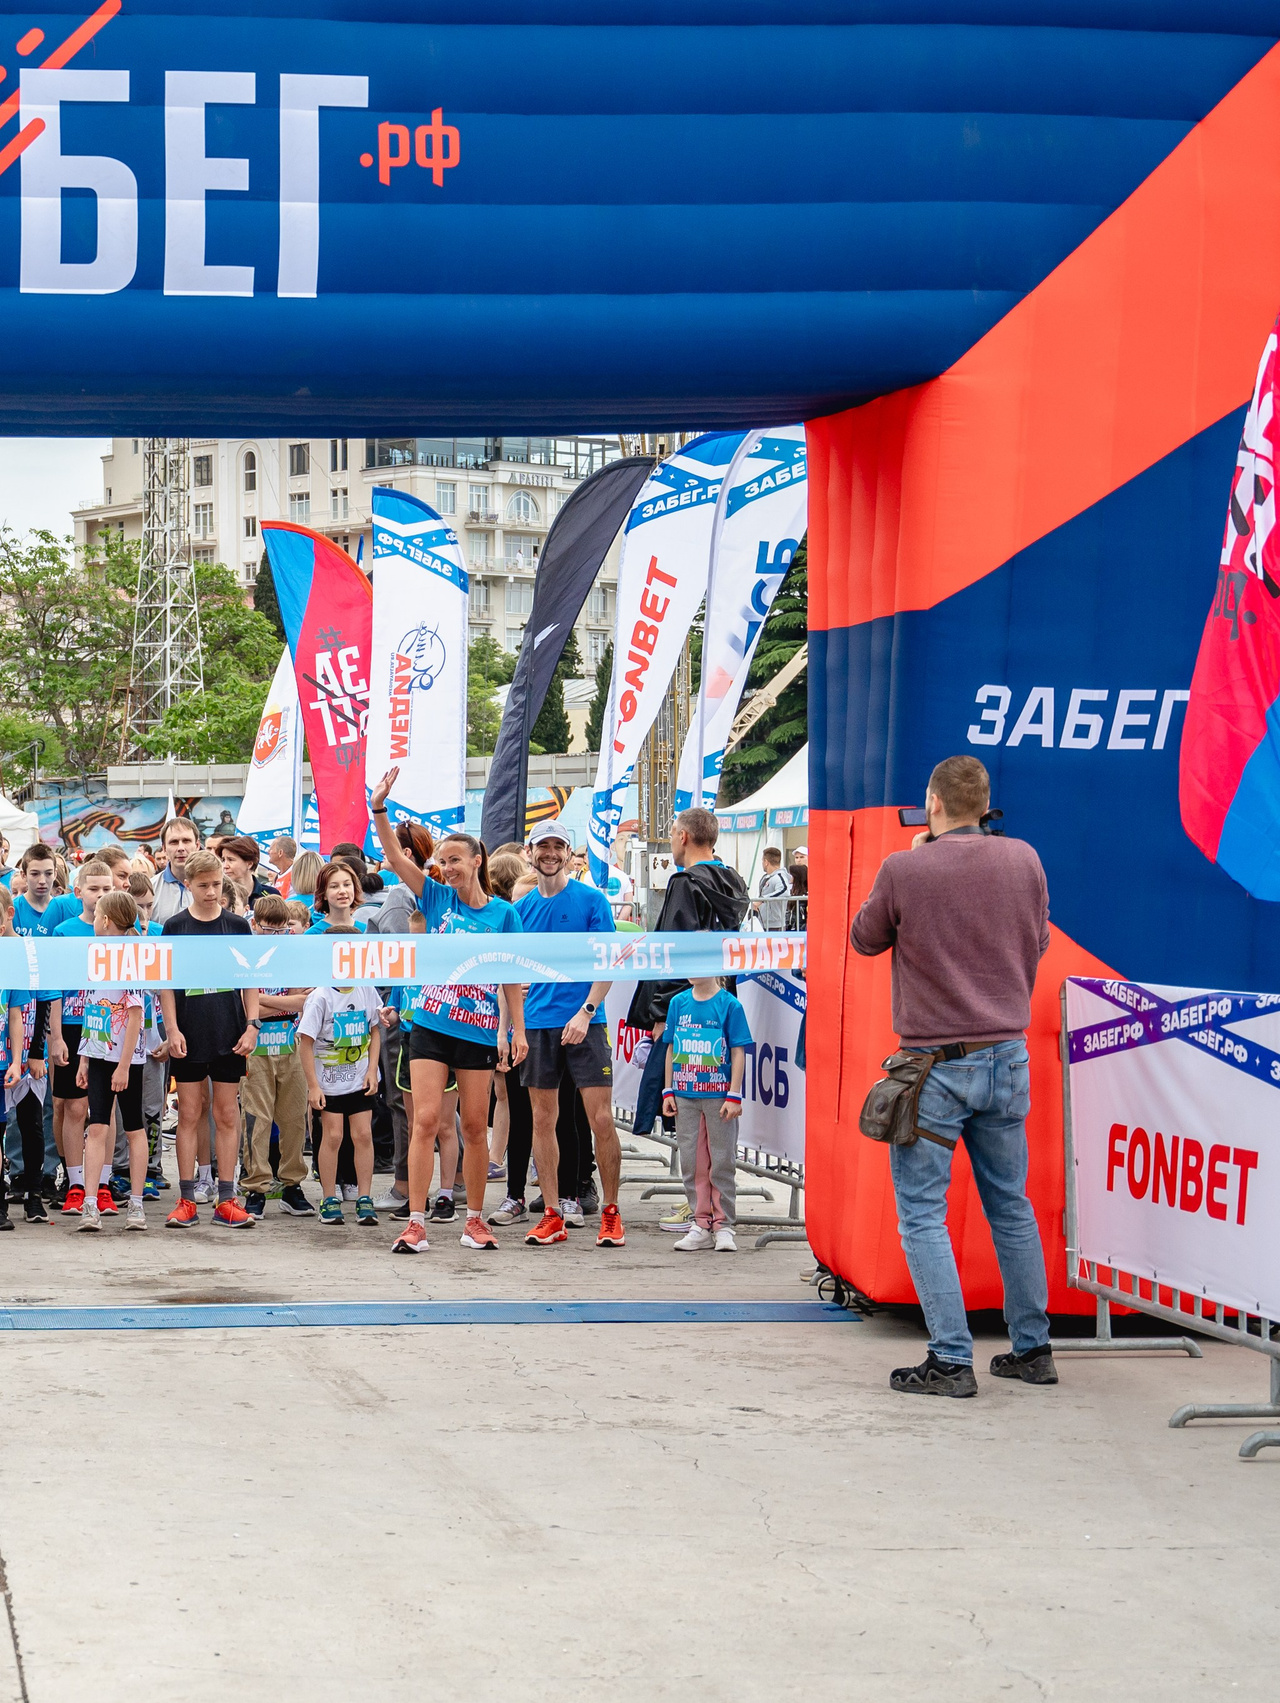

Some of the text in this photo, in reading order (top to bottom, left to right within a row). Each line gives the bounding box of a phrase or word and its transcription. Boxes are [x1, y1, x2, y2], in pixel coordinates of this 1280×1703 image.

[88, 942, 173, 982] СТАРТ
[332, 940, 416, 980] СТАРТ
[722, 937, 805, 970] СТАРТ
[258, 1031, 287, 1045] 10005
[344, 1022, 365, 1036] 10145
[1083, 997, 1232, 1054] ЗАБЕГ.РФ ЗАБЕГ.РФ
[681, 1038, 712, 1054] 10080
[1106, 1122, 1259, 1226] FONBET
